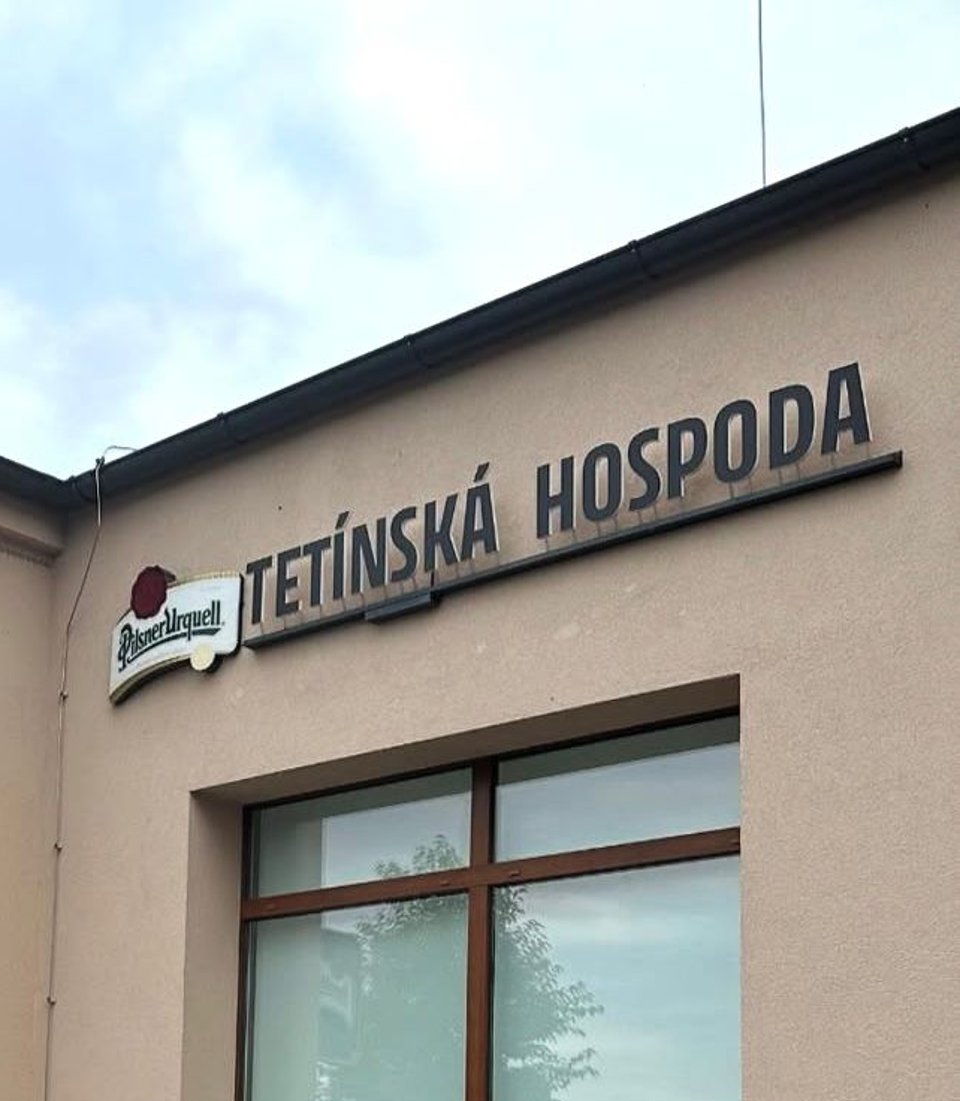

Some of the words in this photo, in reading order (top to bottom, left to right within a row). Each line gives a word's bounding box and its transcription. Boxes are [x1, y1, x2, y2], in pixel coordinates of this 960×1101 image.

[246, 463, 499, 623] TETÍNSKÁ
[536, 363, 871, 538] HOSPODA
[118, 623, 166, 673] Pilsner
[164, 600, 221, 641] Urquell
